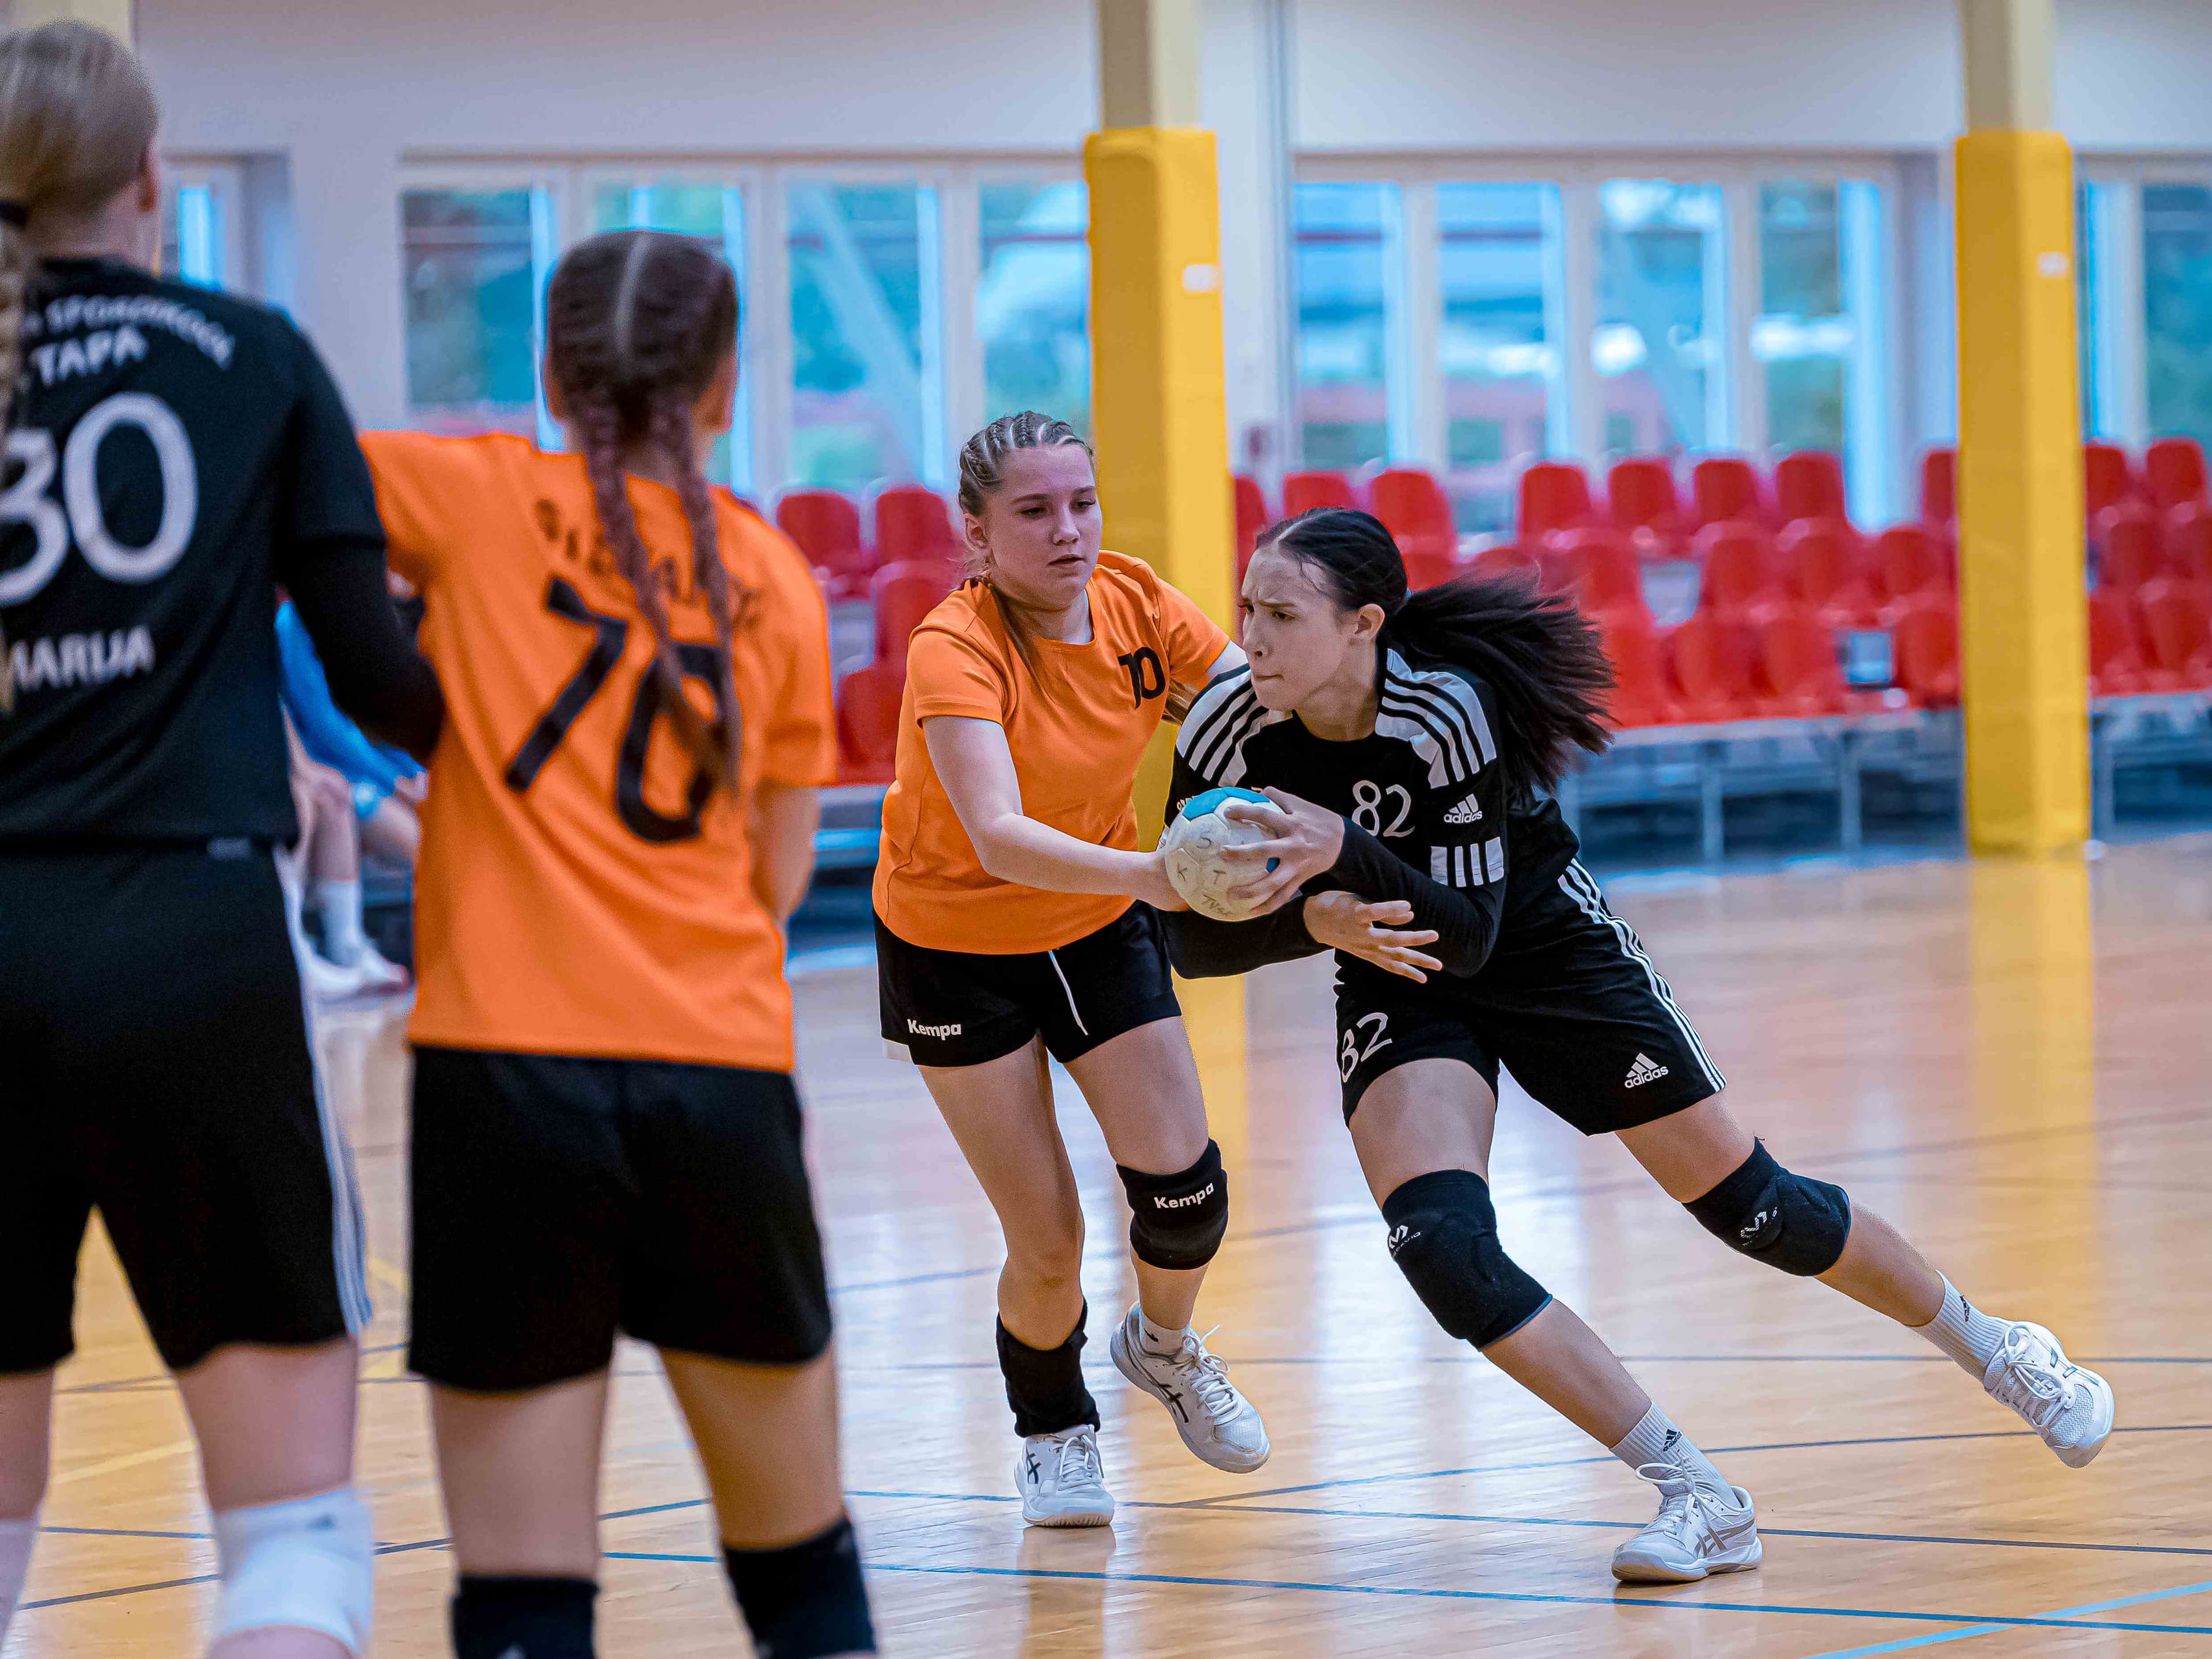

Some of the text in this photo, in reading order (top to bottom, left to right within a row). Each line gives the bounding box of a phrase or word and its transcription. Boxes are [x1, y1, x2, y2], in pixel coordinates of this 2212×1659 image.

[30, 324, 148, 387] TAPA
[0, 391, 199, 608] 30
[1118, 646, 1166, 710] 10
[1351, 780, 1415, 837] 82
[1444, 810, 1482, 823] adidas
[907, 1018, 961, 1040] Kempa
[1342, 1012, 1393, 1083] 82
[1624, 1066, 1669, 1088] adidas
[1154, 1183, 1214, 1209] Kempa
